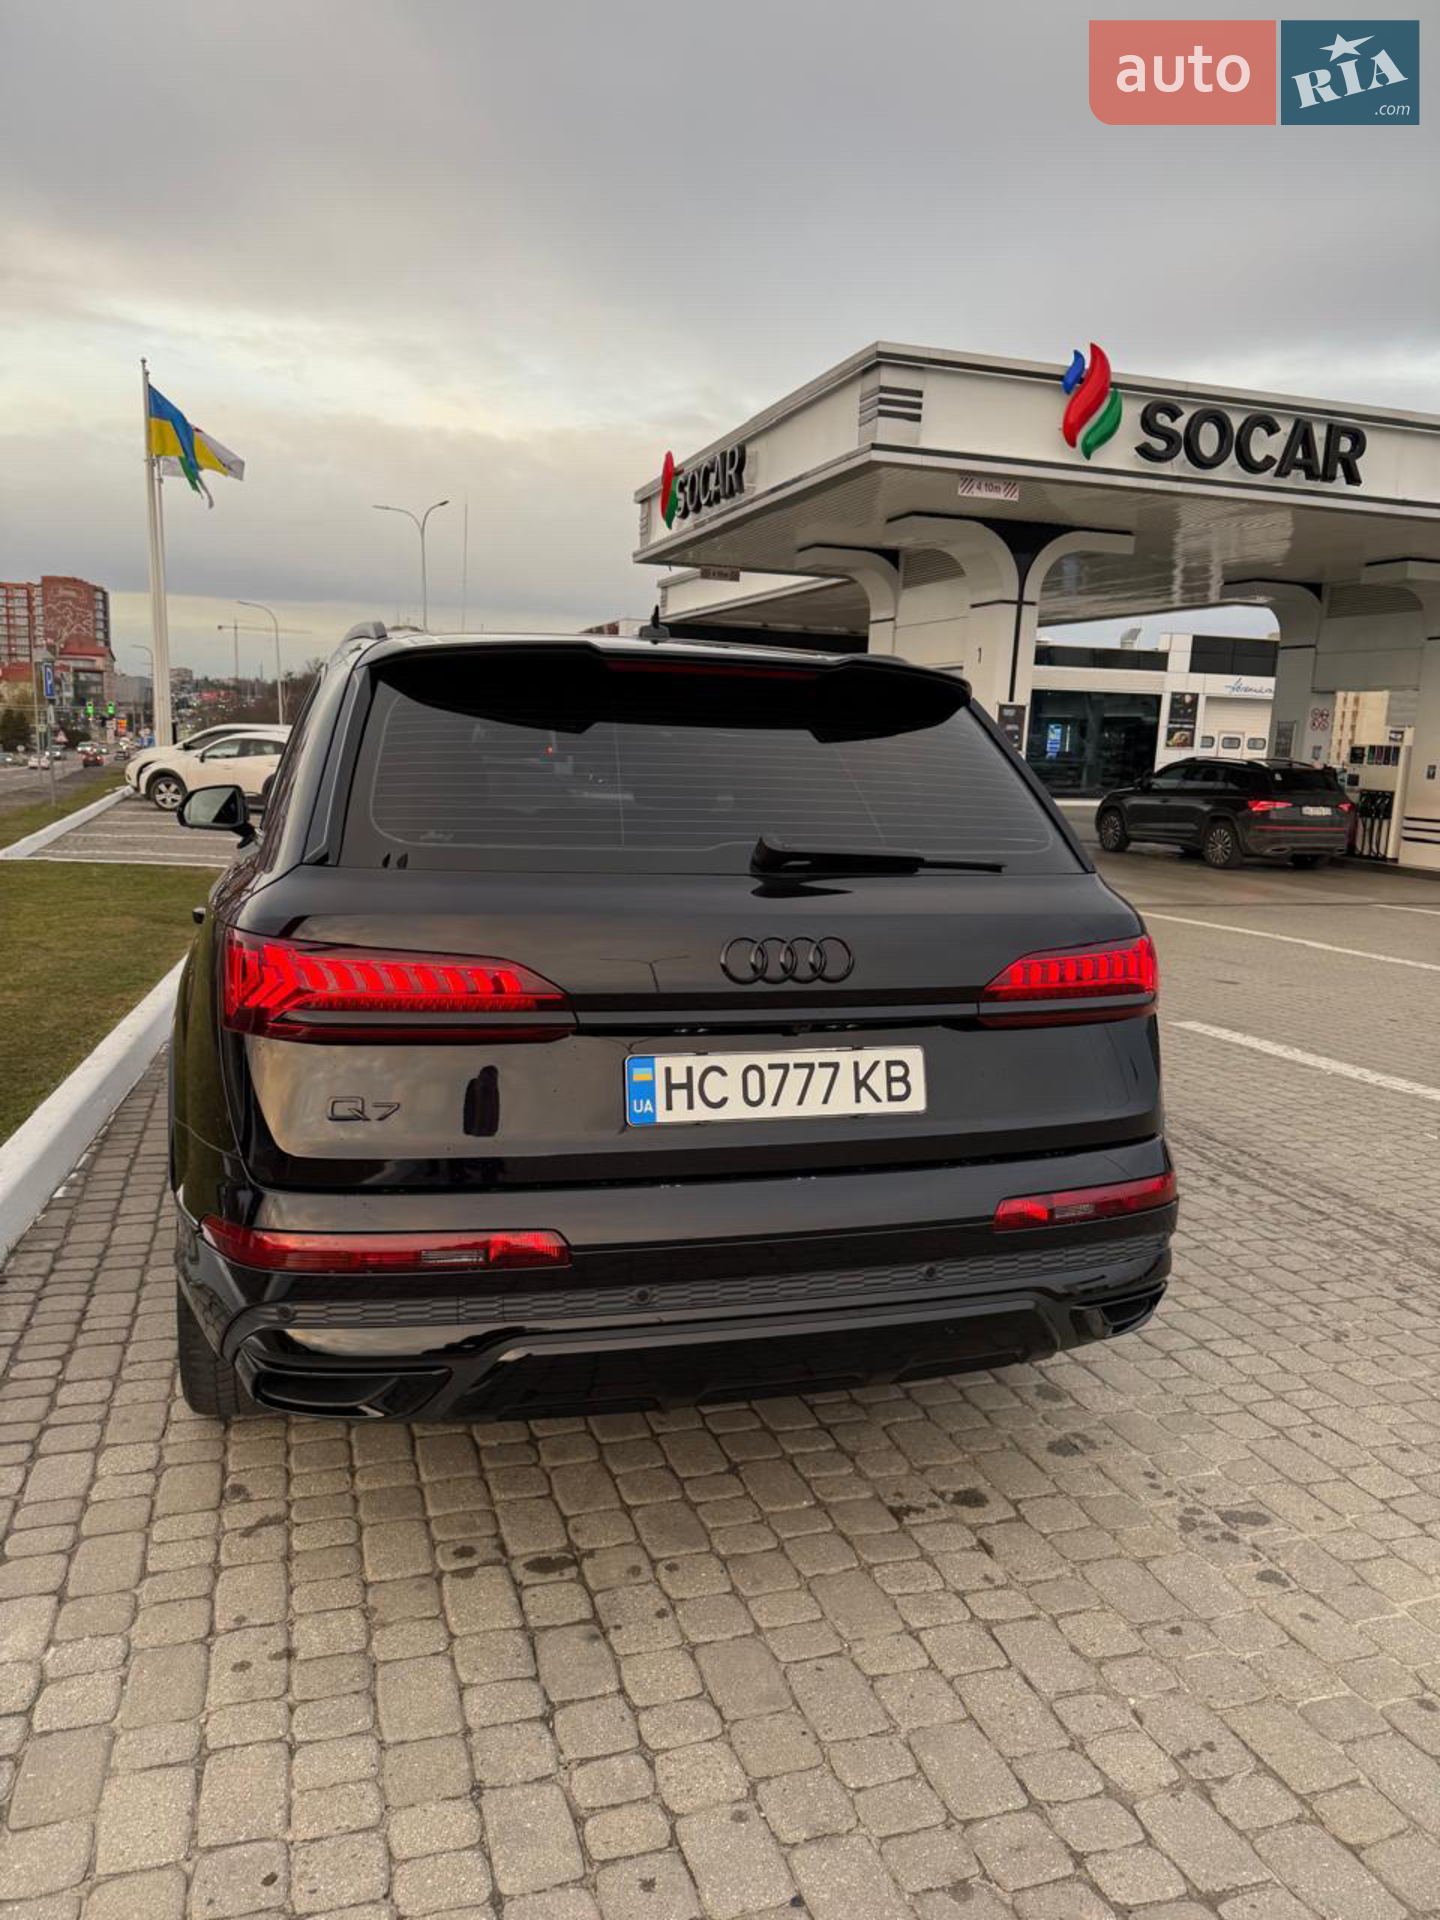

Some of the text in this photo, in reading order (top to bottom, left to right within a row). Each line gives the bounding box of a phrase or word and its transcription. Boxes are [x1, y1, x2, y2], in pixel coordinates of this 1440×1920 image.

[1134, 400, 1368, 487] SOCAR
[674, 443, 746, 519] SOCAR
[326, 1096, 401, 1122] Q7
[632, 1059, 912, 1114] UA HC 0777 KB
